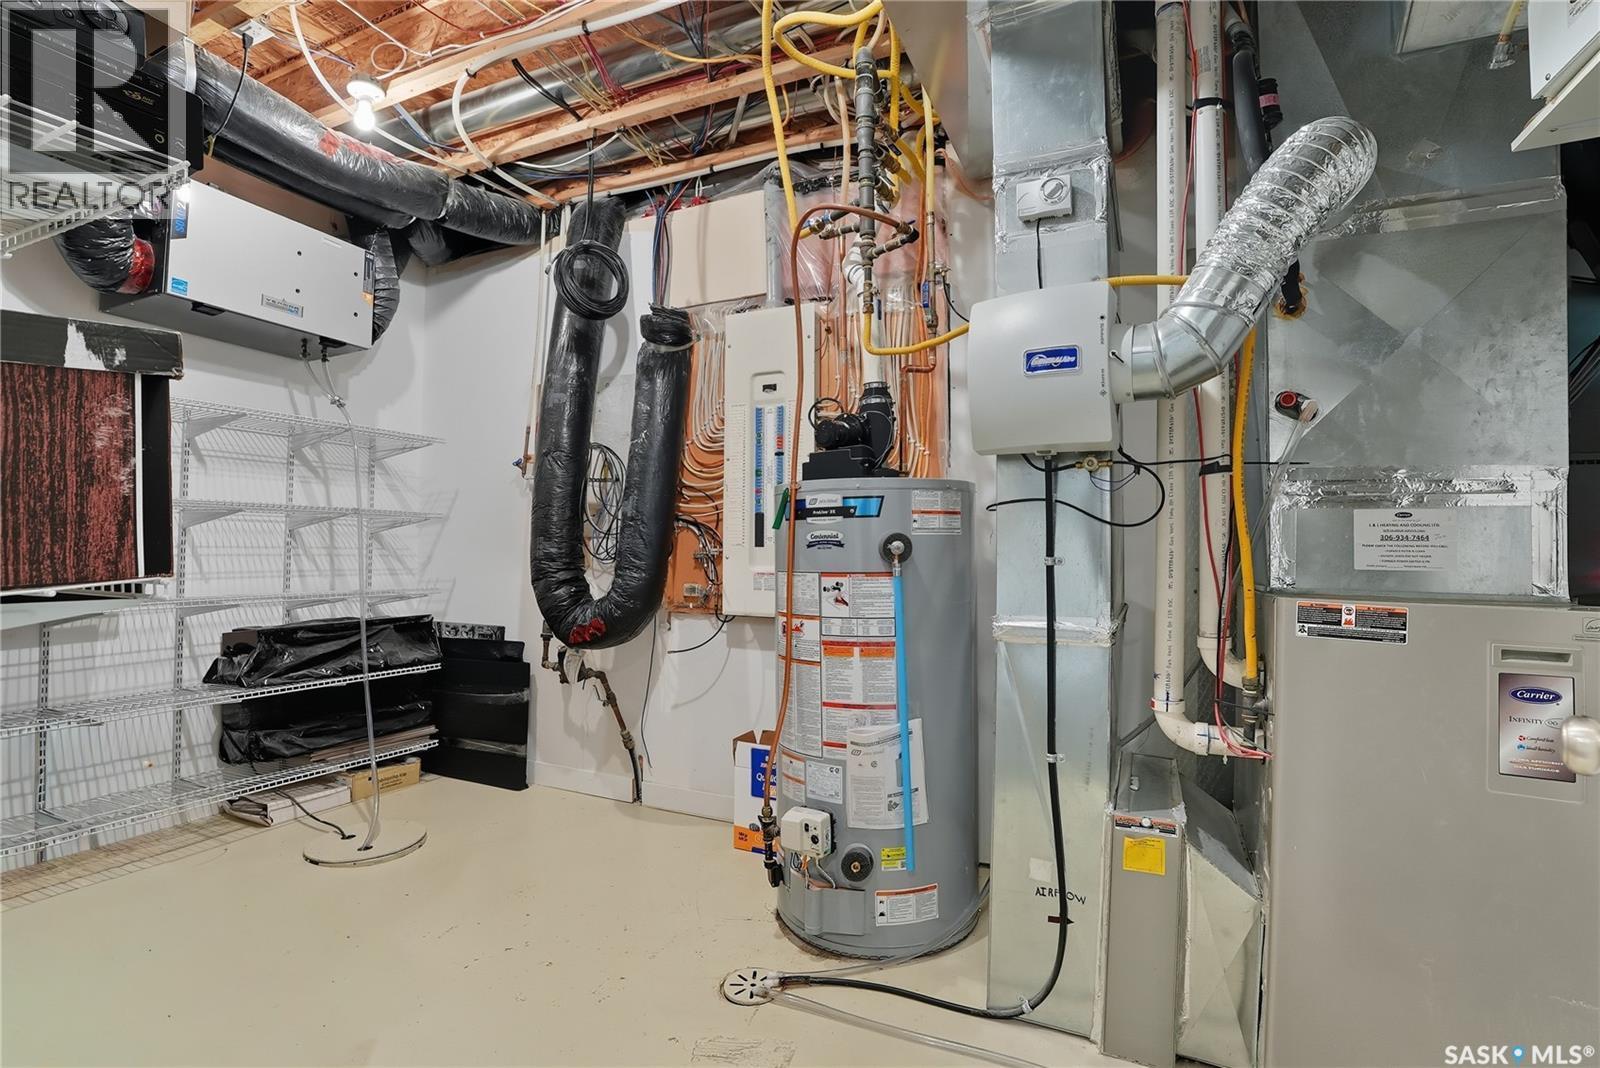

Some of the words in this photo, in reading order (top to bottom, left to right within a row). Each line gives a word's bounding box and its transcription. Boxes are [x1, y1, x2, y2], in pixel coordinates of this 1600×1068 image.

[810, 532, 839, 540] Centennial
[1516, 690, 1556, 700] Carrier
[1509, 715, 1544, 724] INFINITY
[1035, 886, 1087, 905] AIRFOW
